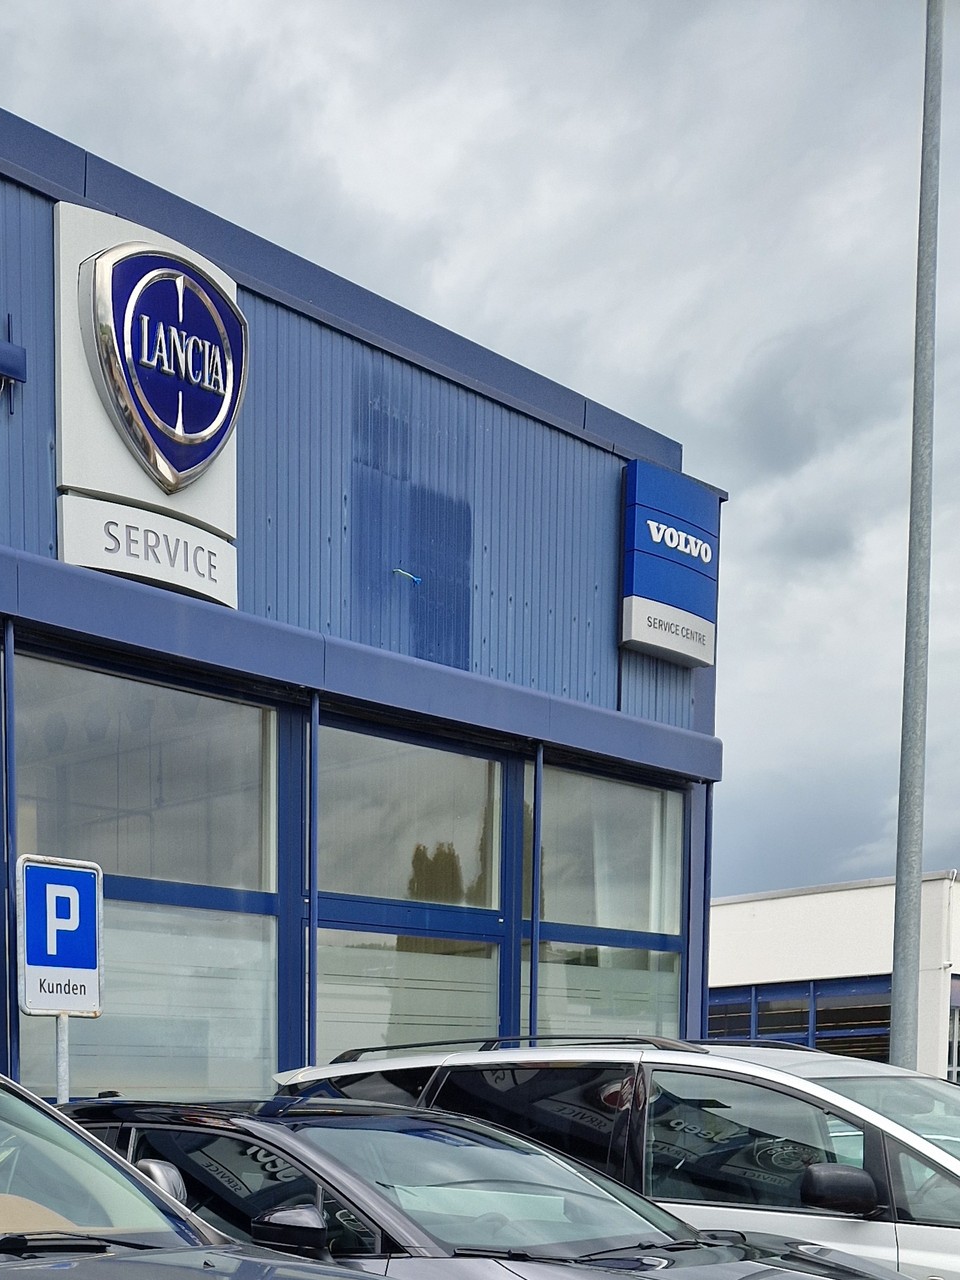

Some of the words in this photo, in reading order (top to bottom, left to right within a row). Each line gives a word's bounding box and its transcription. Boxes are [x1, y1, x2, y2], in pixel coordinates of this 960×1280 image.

[140, 314, 226, 395] LANCIA
[104, 520, 218, 584] SERVICE
[646, 520, 712, 563] VOLVO
[647, 616, 680, 636] SERVICE
[681, 626, 706, 646] CENTRE
[46, 883, 80, 955] P
[39, 979, 86, 995] Kunden
